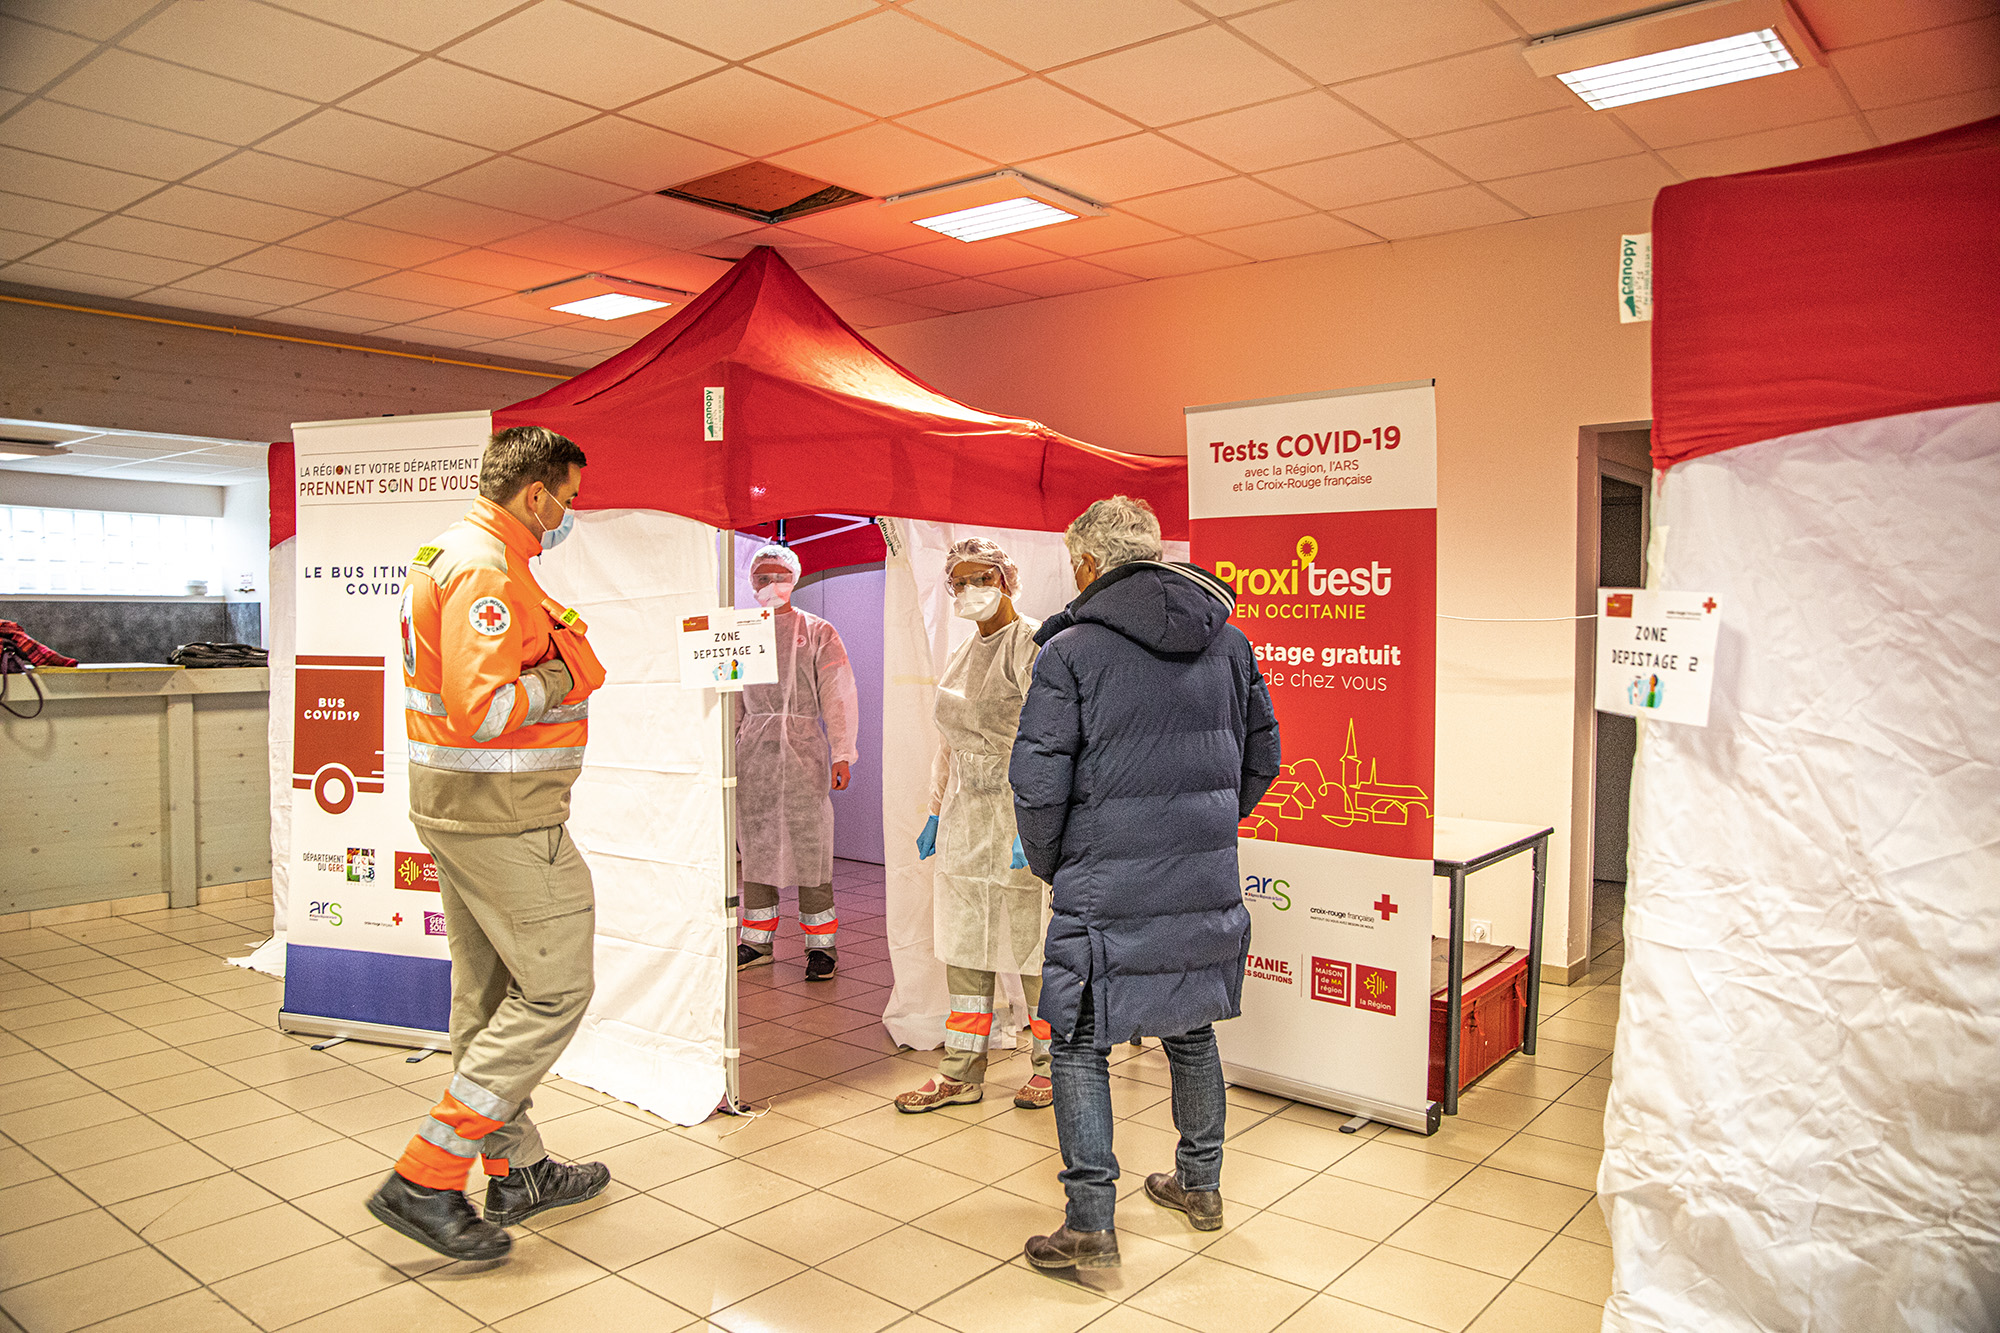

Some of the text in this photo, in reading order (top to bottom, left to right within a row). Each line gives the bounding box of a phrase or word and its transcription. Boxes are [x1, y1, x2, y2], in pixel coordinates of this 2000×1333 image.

[1622, 239, 1637, 295] canopy
[1209, 425, 1401, 463] Tests COVID-19
[300, 458, 479, 477] LA RÉGION ET VOTRE DÉPARTEMENT
[1245, 468, 1270, 478] avec
[1273, 465, 1282, 476] la
[1285, 463, 1326, 478] Région,
[300, 475, 479, 496] PRENNENT SOIN DE VOUS
[1233, 474, 1372, 492] et la Croix-Rouge française
[305, 567, 322, 578] LE
[331, 567, 364, 578] BUS
[1215, 559, 1392, 597] Proxi test
[346, 583, 400, 595] COVID
[1236, 604, 1366, 619] EN OCCITANIE
[714, 631, 740, 642] ZONE
[1635, 625, 1668, 642] ZONE
[694, 644, 765, 660] DEPISTAGE 1
[1249, 641, 1401, 667] stage gratuit
[1612, 649, 1698, 672] DEPISTAGE 2
[1262, 668, 1387, 691] de chez vous
[318, 698, 345, 708] BUS
[304, 709, 360, 721] COVID19
[303, 851, 344, 863] DÉPARTEMENT
[318, 863, 344, 872] DU GERS
[1309, 907, 1375, 924] croix-rouge française
[1253, 970, 1293, 985] SOLUTIONS
[1315, 967, 1343, 977] MAISON
[1331, 978, 1343, 986] MA
[1320, 985, 1343, 995] région
[1367, 999, 1391, 1011] Région
